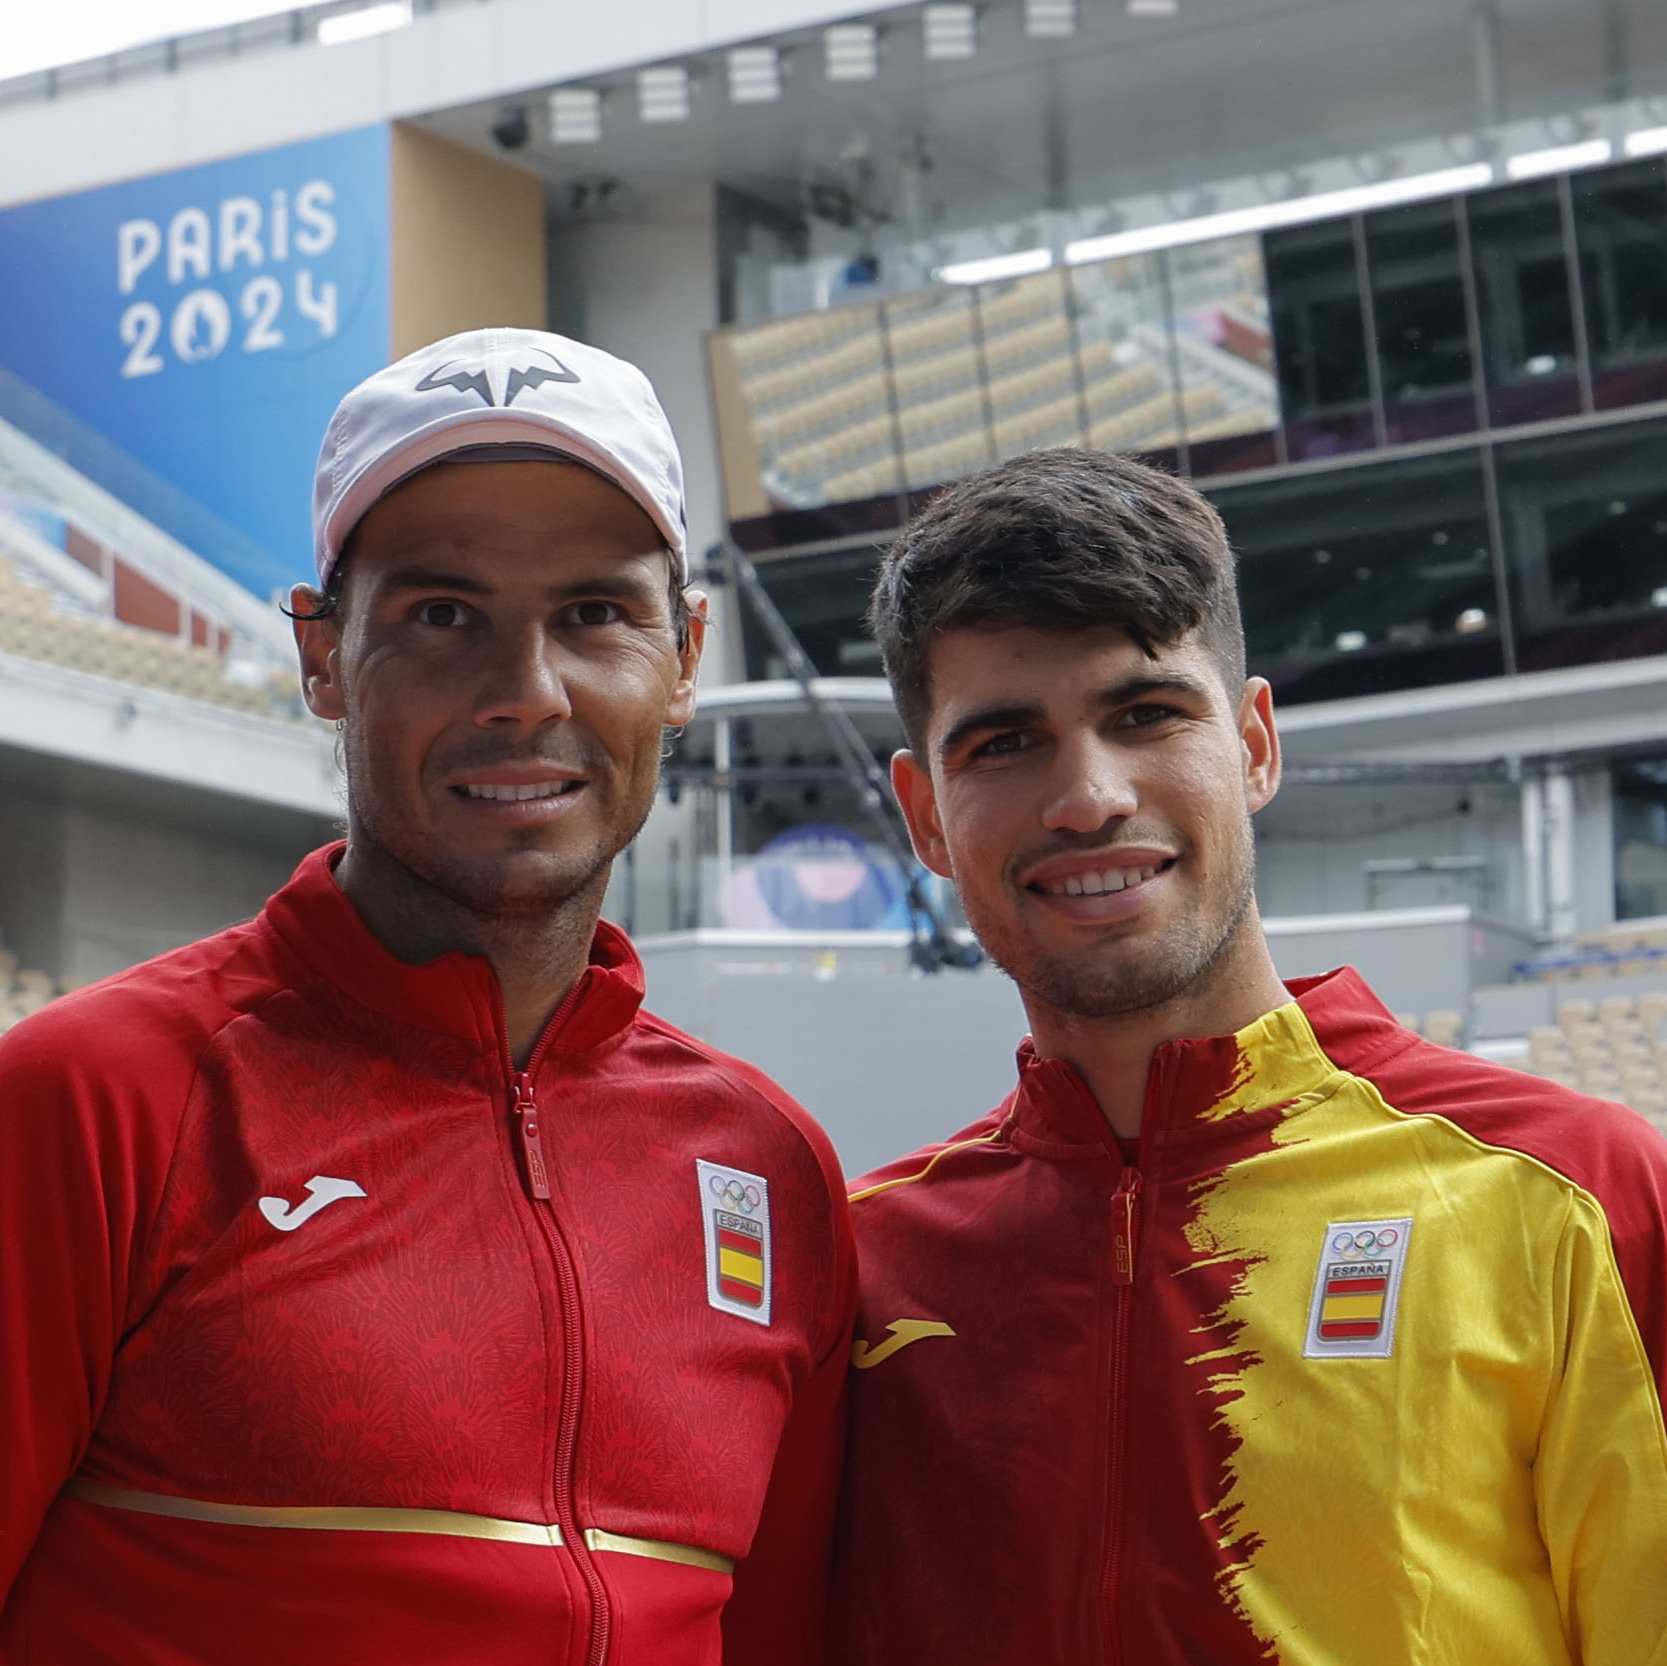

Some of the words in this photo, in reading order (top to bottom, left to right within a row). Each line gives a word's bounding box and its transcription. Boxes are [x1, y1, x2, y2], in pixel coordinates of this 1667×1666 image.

[120, 268, 338, 379] 2024
[1116, 1234, 1130, 1274] ESP
[1332, 1262, 1384, 1277] ESPAÑA
